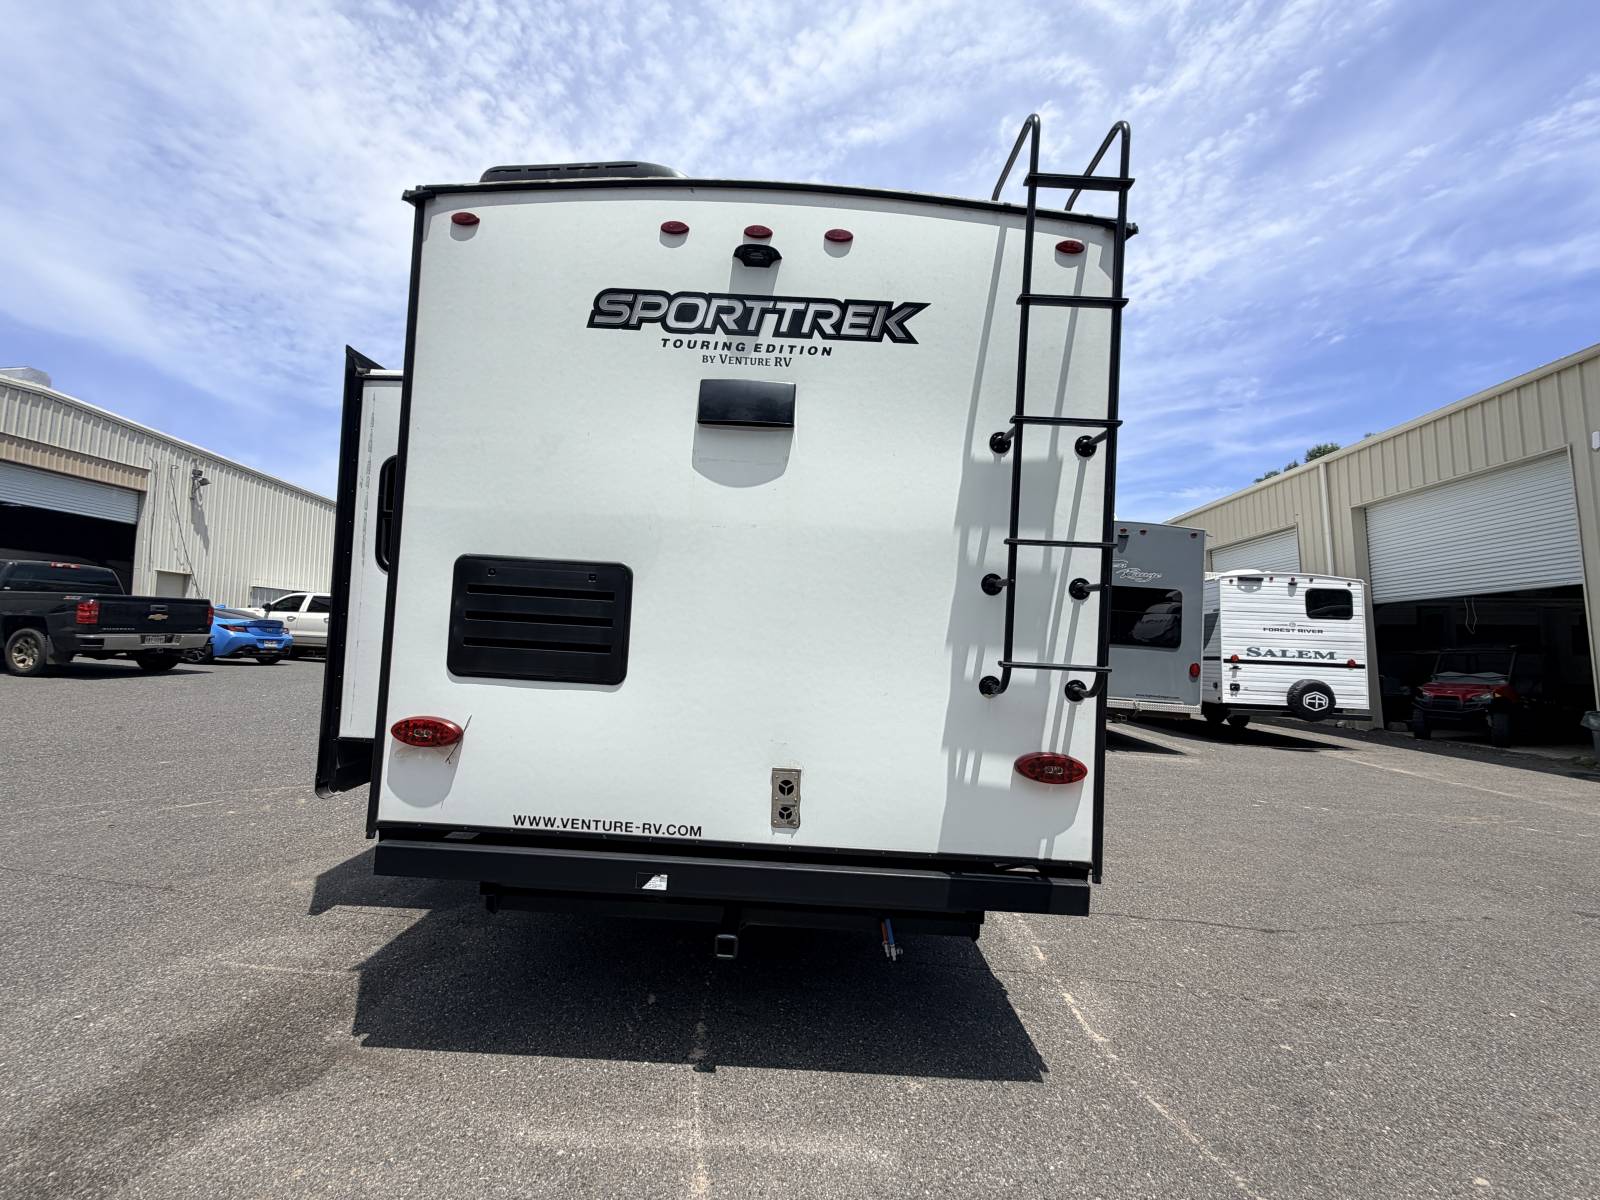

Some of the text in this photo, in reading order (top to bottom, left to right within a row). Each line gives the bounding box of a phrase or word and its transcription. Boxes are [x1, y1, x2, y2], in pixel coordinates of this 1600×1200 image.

[587, 288, 931, 344] SPORTTREK
[661, 338, 832, 356] TOURING EDITION
[702, 355, 716, 364] BY
[774, 356, 792, 368] RV
[1246, 647, 1337, 661] SALEM
[513, 814, 702, 838] WWW.VENTURE-RV.COM
